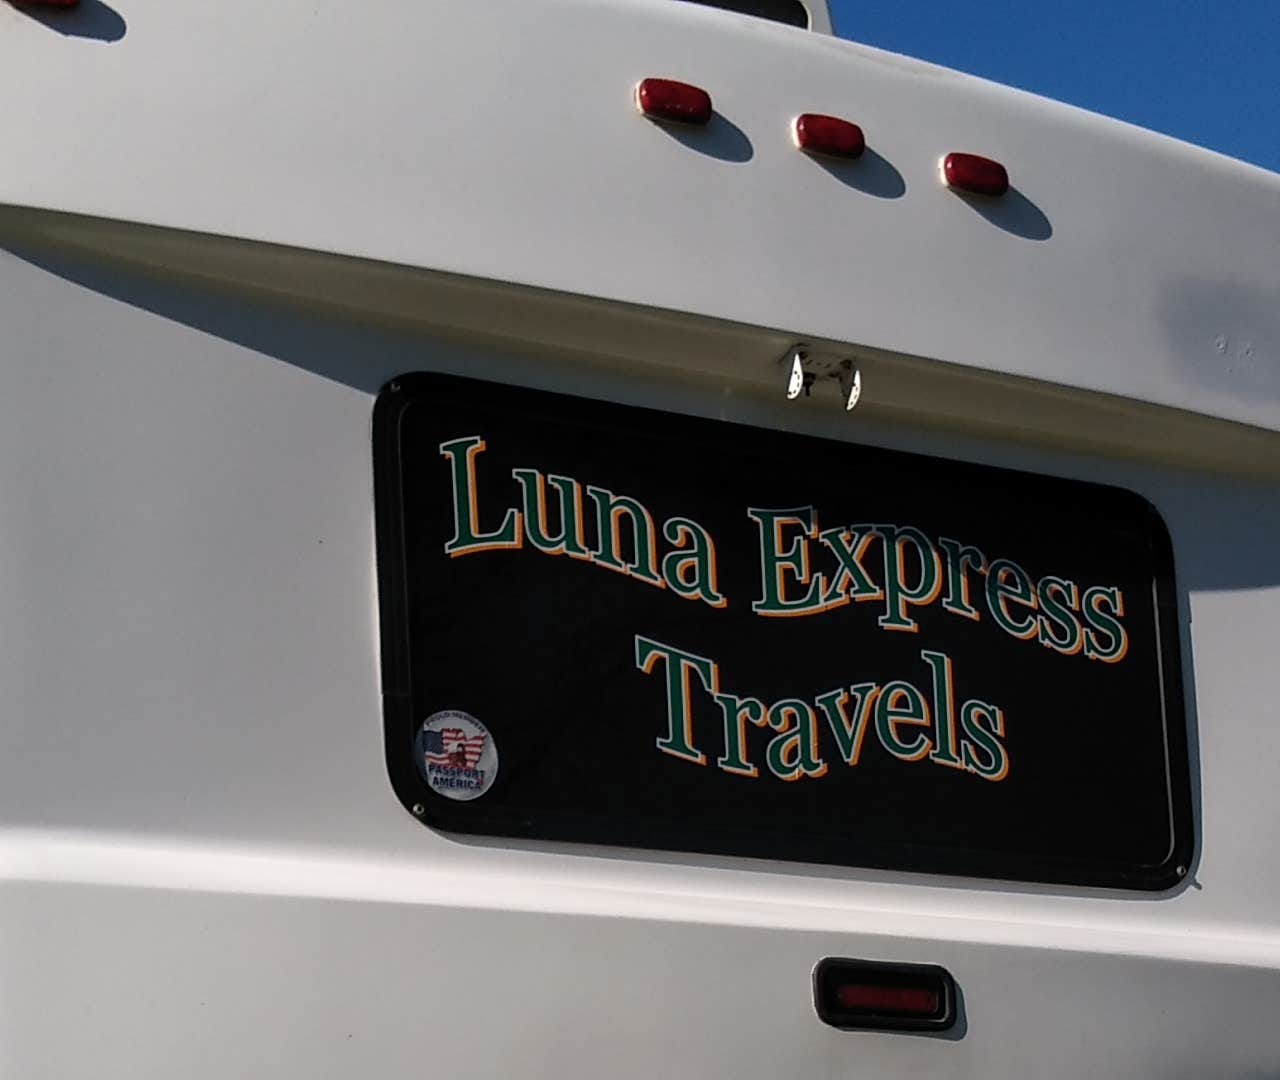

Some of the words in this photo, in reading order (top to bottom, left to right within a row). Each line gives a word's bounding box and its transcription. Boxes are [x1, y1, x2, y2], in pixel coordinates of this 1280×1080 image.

[439, 436, 727, 608] Luna
[747, 506, 1128, 663] Express
[635, 635, 1009, 781] Travels
[428, 764, 486, 779] PASSPORT
[432, 777, 484, 790] AMERICA
